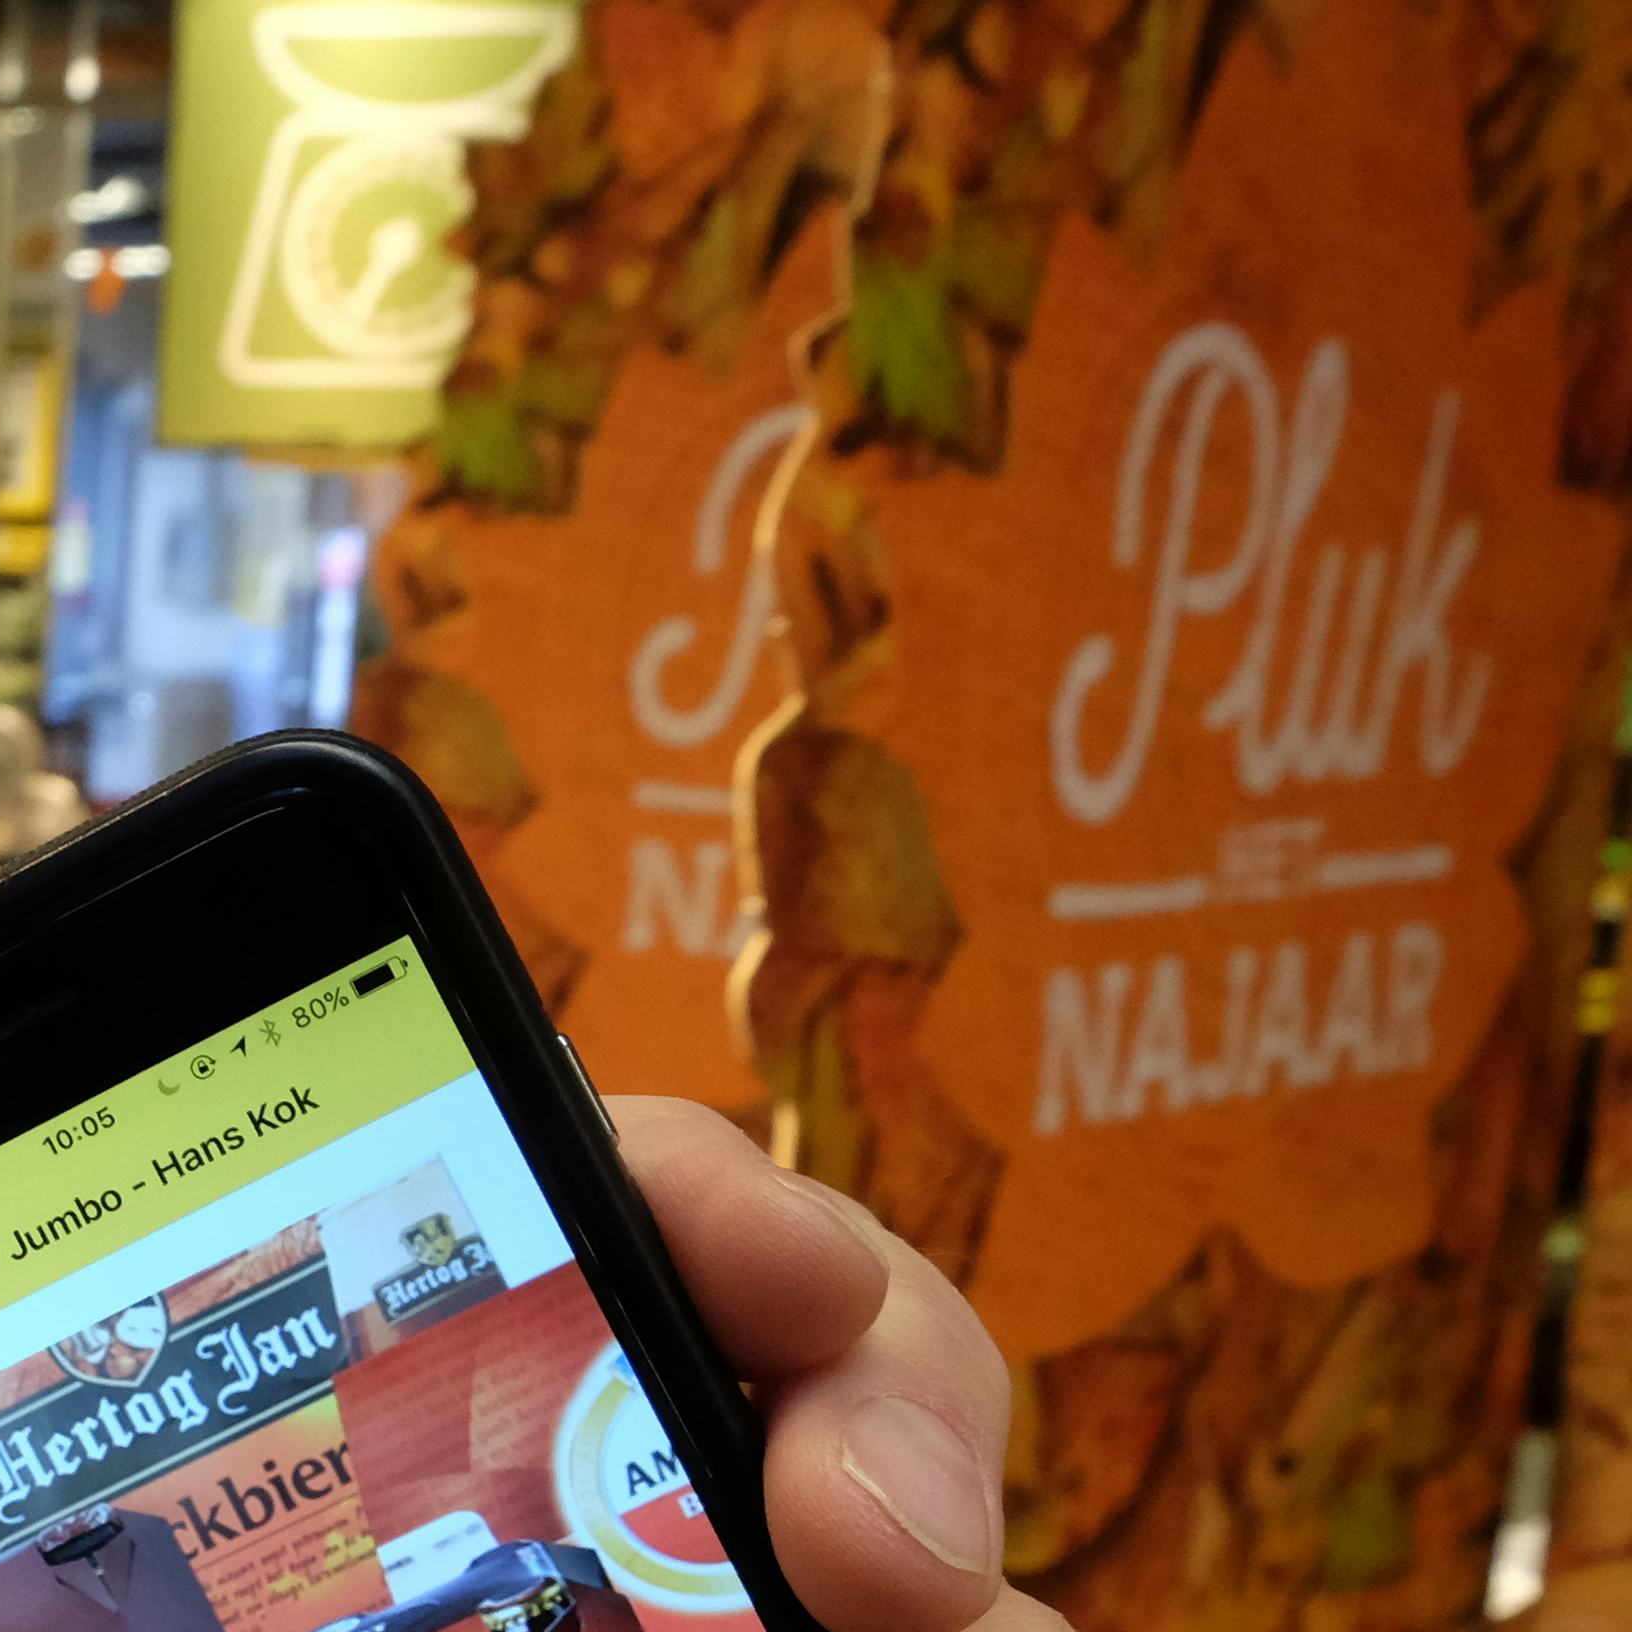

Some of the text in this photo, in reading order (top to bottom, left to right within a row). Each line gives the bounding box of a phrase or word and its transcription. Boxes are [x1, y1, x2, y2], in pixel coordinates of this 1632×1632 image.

[1049, 320, 1493, 824] Pluk
[291, 986, 350, 1029] 80%
[1034, 921, 1444, 1138] NAJAAR
[10, 1190, 122, 1260] Jumbo
[152, 1126, 245, 1186] Hans
[247, 1087, 320, 1136] Kok
[42, 1107, 116, 1155] 10:05
[383, 1260, 468, 1318] Hertog
[196, 1305, 337, 1416] Jan
